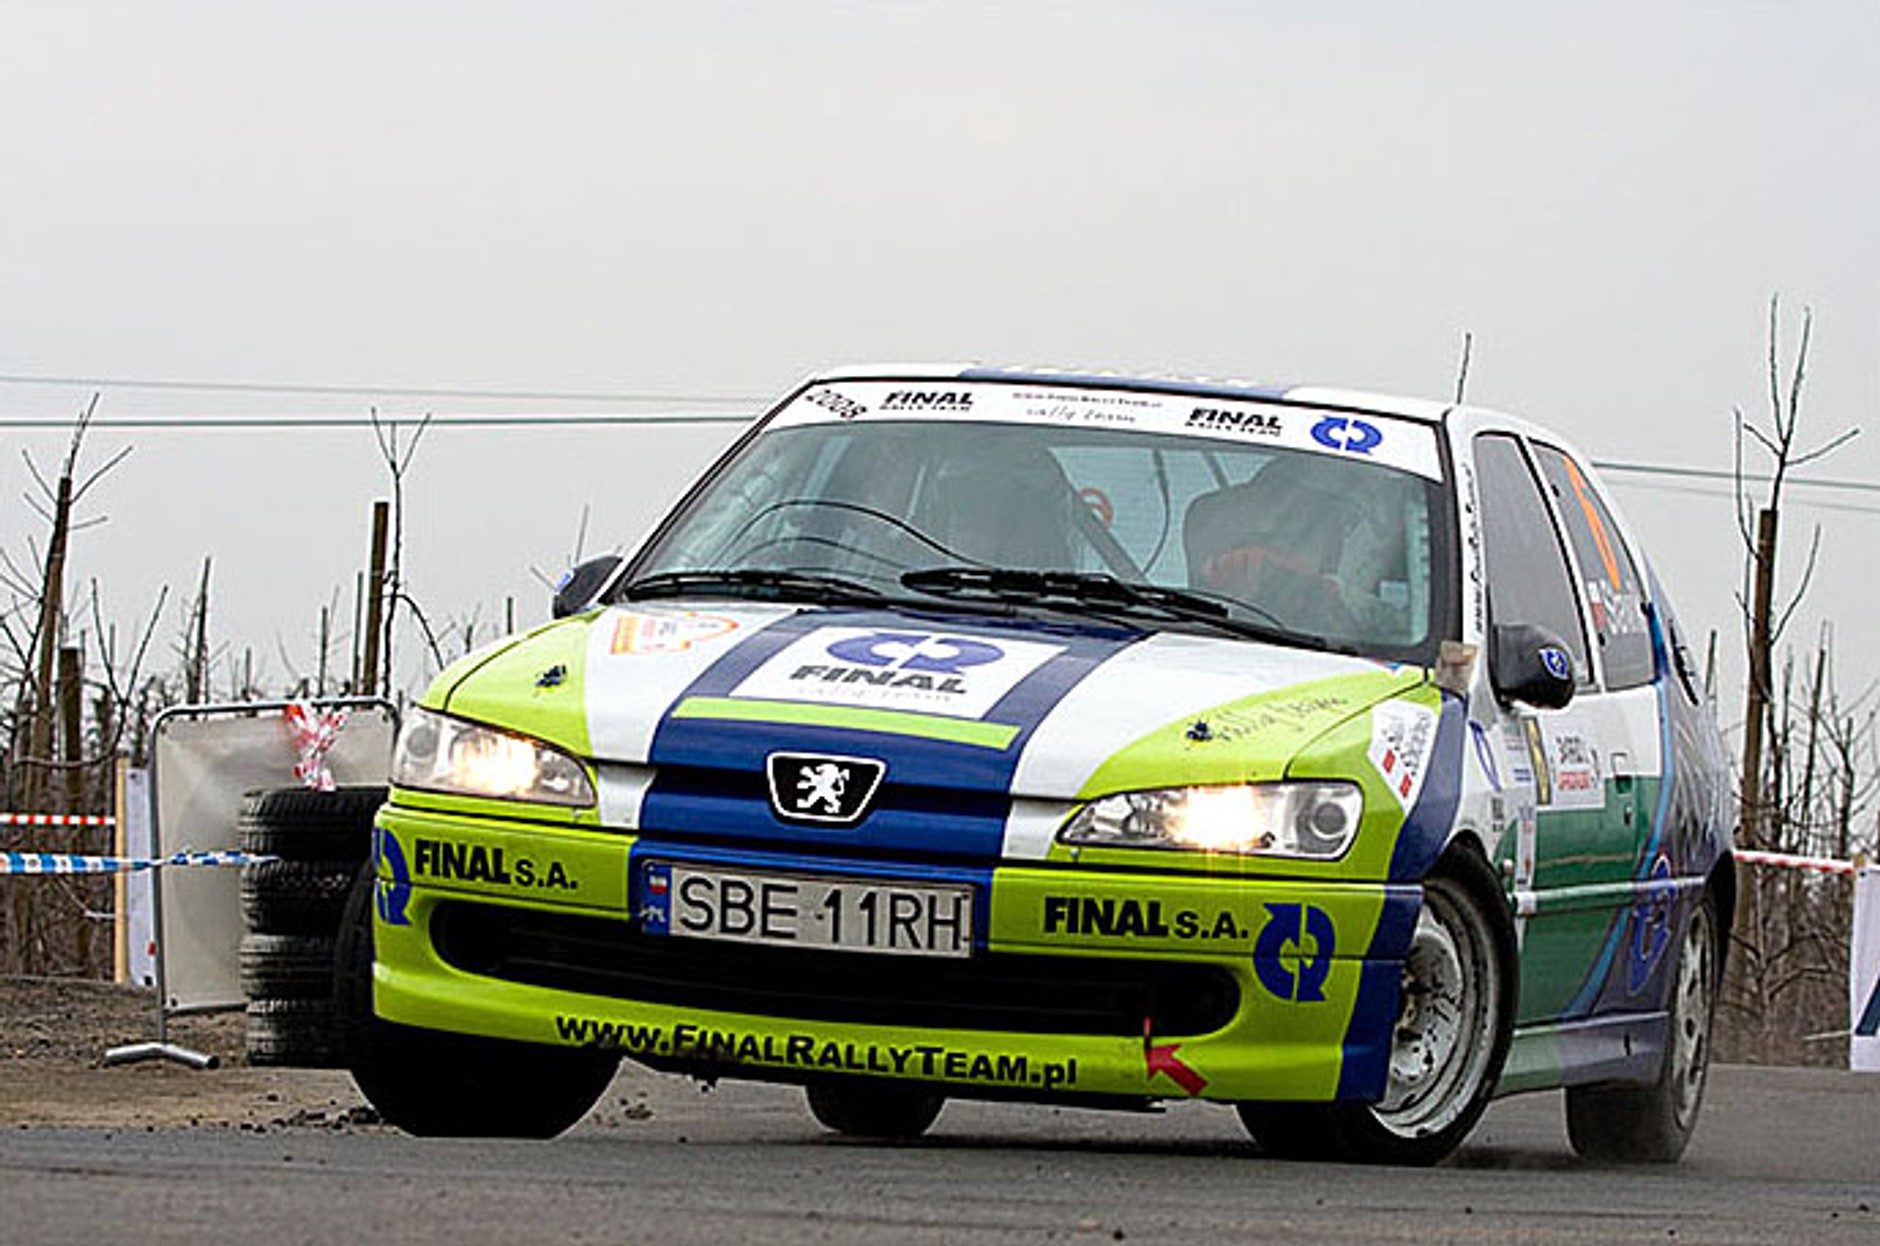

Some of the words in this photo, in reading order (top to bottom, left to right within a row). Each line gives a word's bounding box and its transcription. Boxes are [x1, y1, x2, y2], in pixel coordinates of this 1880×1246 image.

[884, 391, 974, 406] FINAL
[1189, 408, 1283, 429] FINAL
[789, 665, 967, 694] FINAL
[414, 838, 511, 884] FINAL
[679, 876, 799, 939] SBE
[823, 887, 962, 950] 11RH
[1044, 895, 1169, 937] FINAL
